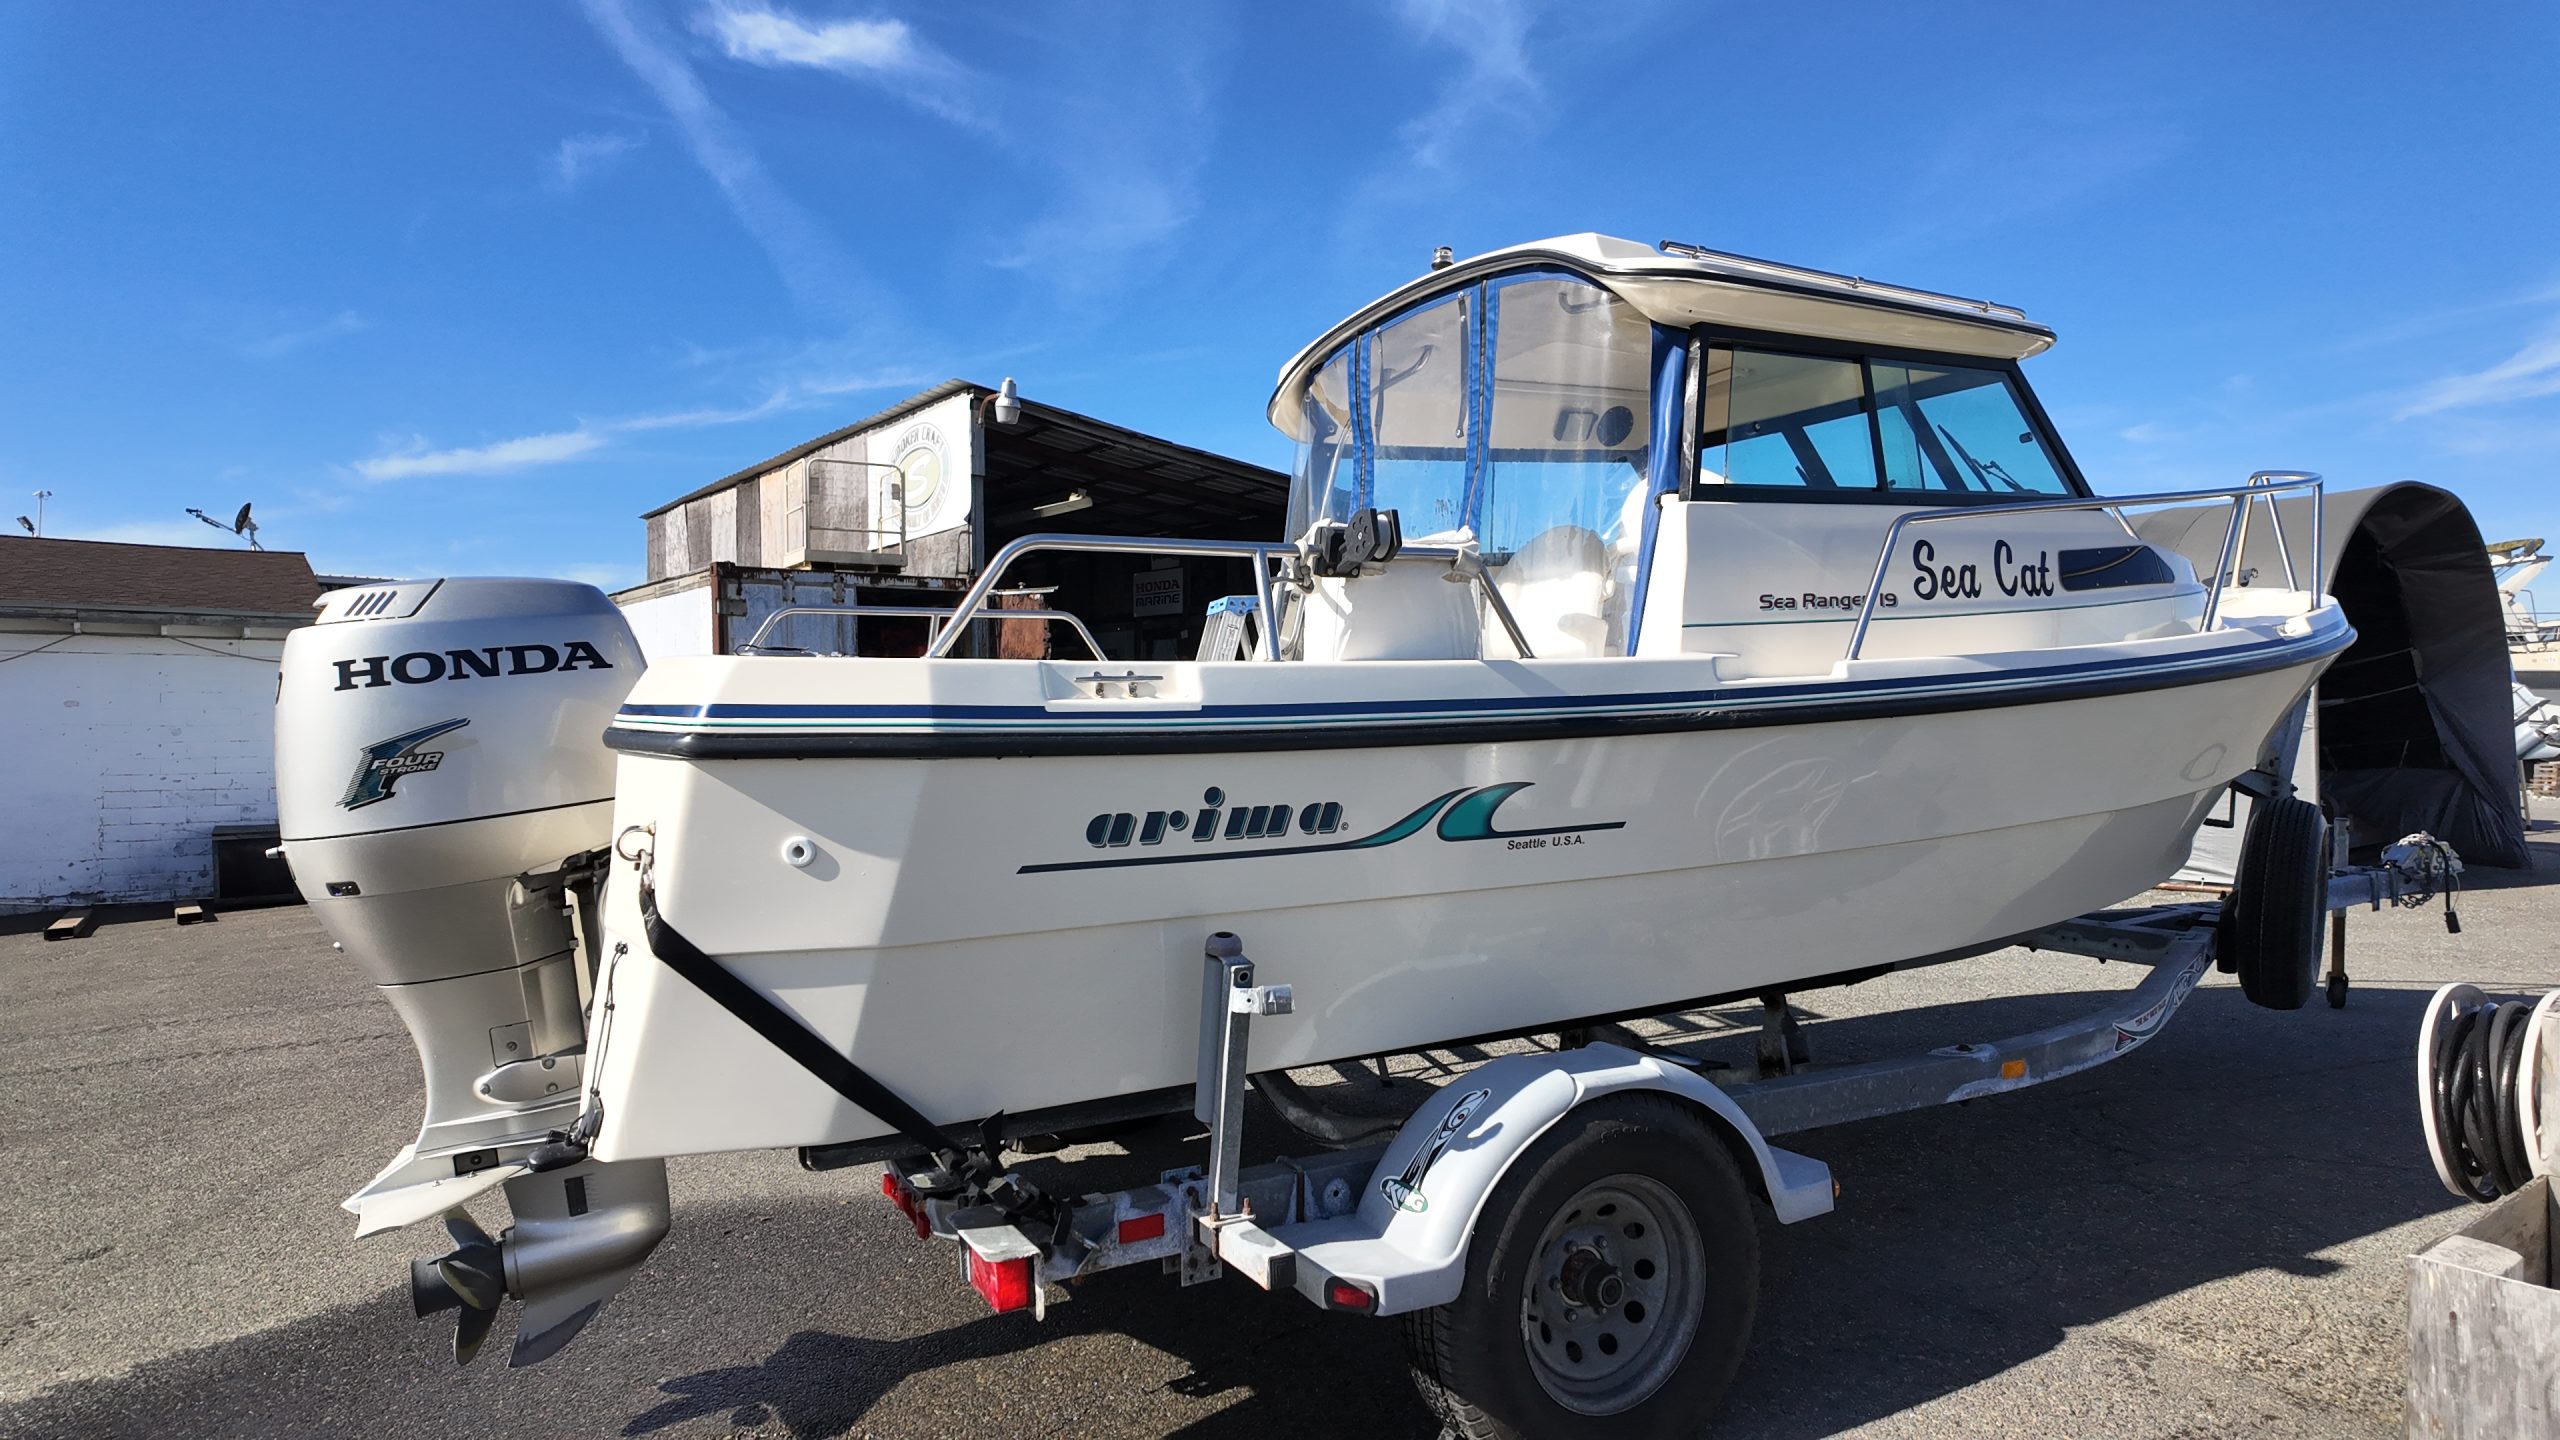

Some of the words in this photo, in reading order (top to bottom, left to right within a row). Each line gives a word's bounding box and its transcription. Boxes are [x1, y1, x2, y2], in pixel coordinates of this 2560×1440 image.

[921, 426, 945, 452] CRAFT
[1912, 539, 1982, 601] Sea
[1993, 539, 2056, 598] Cat
[1135, 579, 1180, 593] HONDA
[1759, 594, 1797, 611] Sea
[1879, 593, 1899, 608] 19
[332, 641, 613, 691] HONDA
[370, 752, 442, 770] FOUR
[380, 762, 437, 775] STROKE
[1085, 786, 1344, 848] arima
[1506, 837, 1547, 850] Seattle
[1552, 834, 1586, 847] U.S.A.
